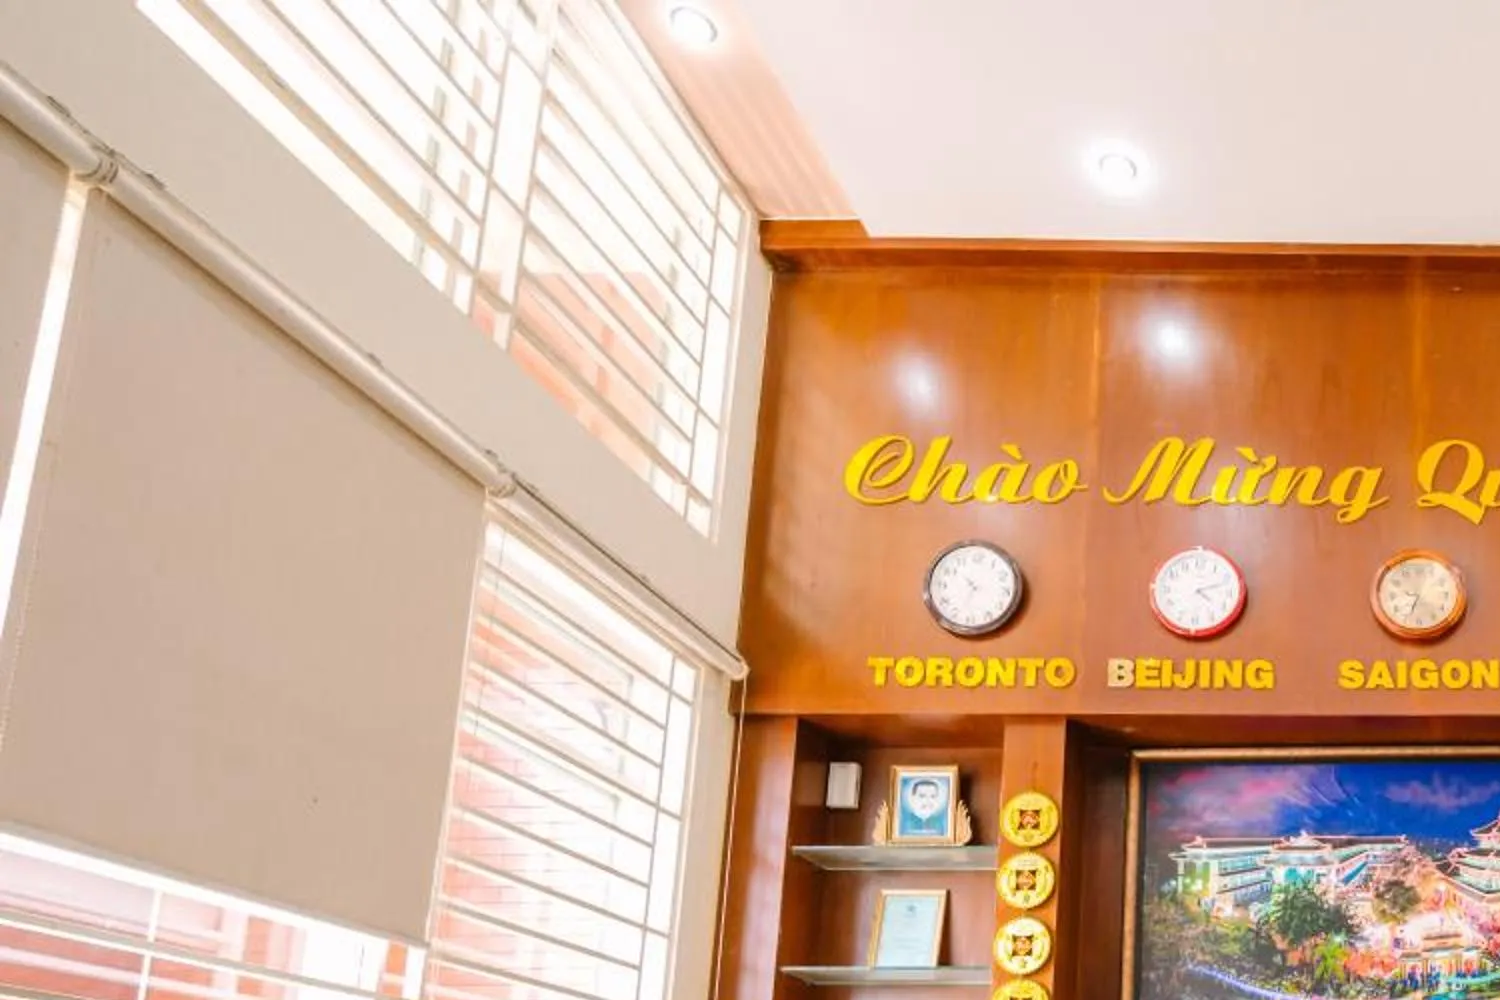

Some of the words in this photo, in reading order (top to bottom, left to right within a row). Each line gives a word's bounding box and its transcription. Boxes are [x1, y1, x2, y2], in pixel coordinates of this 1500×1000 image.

[842, 434, 1088, 505] Chào
[1103, 436, 1390, 523] Mừng
[868, 656, 1076, 688] TORONTO
[1107, 657, 1275, 689] BEIJING
[1338, 658, 1500, 689] SAIGON
